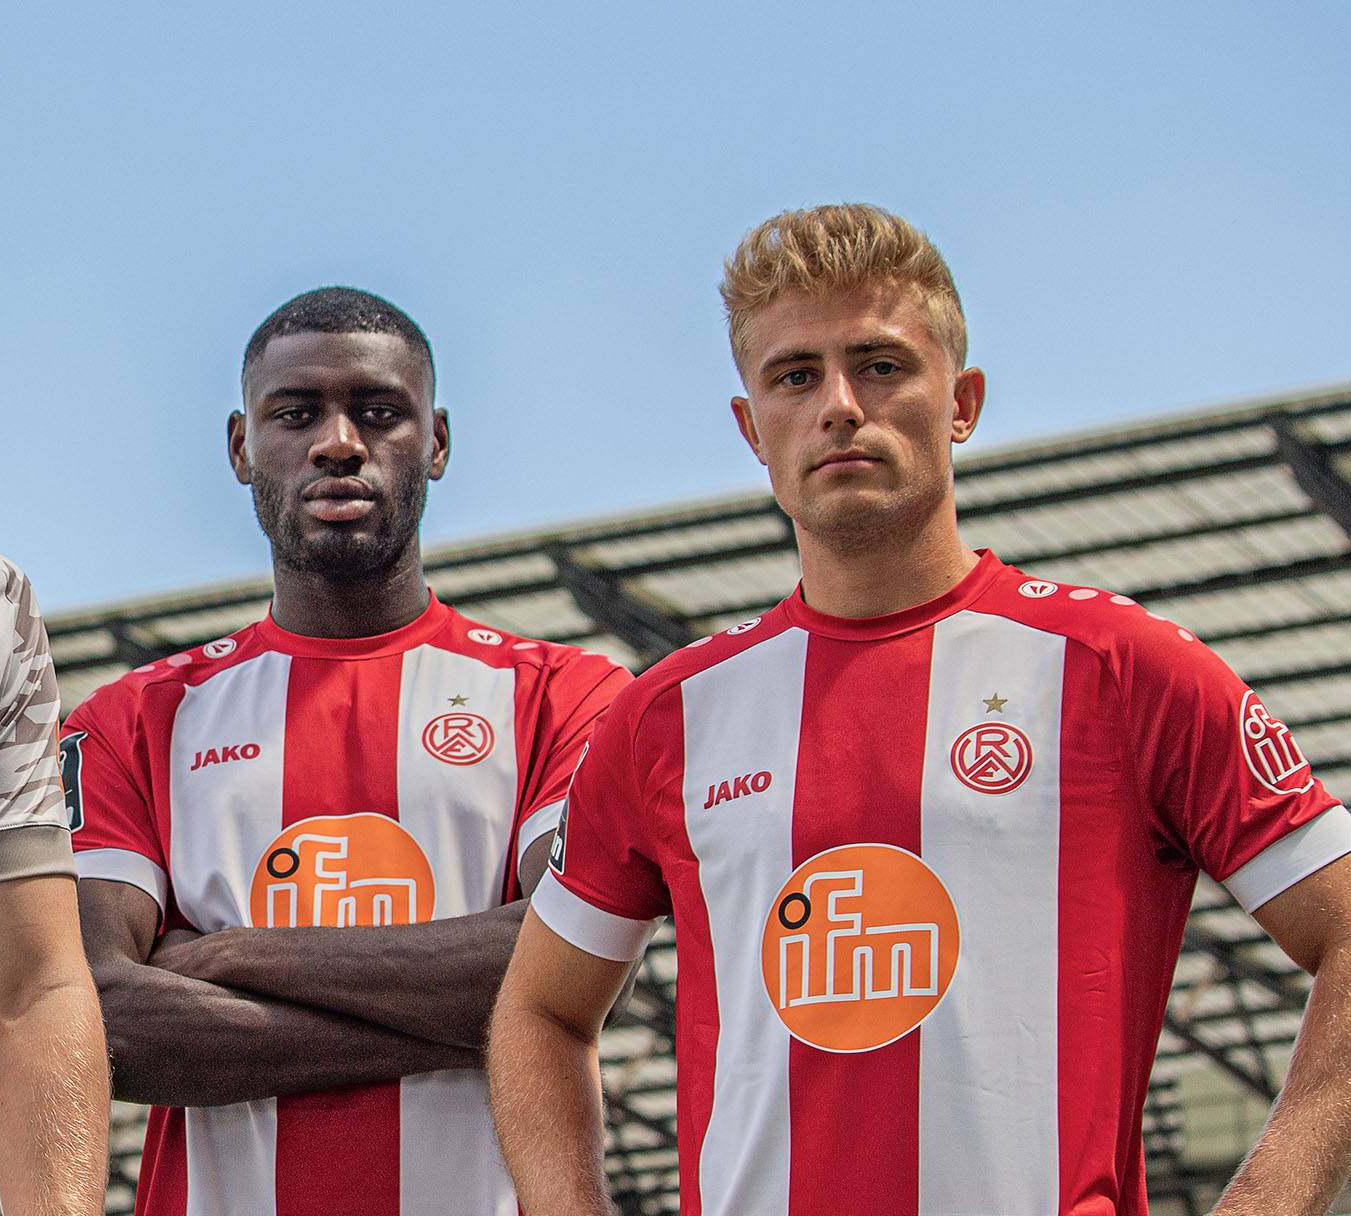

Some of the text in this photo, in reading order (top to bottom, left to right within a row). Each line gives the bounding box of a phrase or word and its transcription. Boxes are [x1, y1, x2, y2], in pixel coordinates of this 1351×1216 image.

[190, 743, 260, 771] JAKO
[704, 771, 772, 809] JAKO
[267, 834, 416, 927] ifm
[778, 869, 938, 1009] ifm
